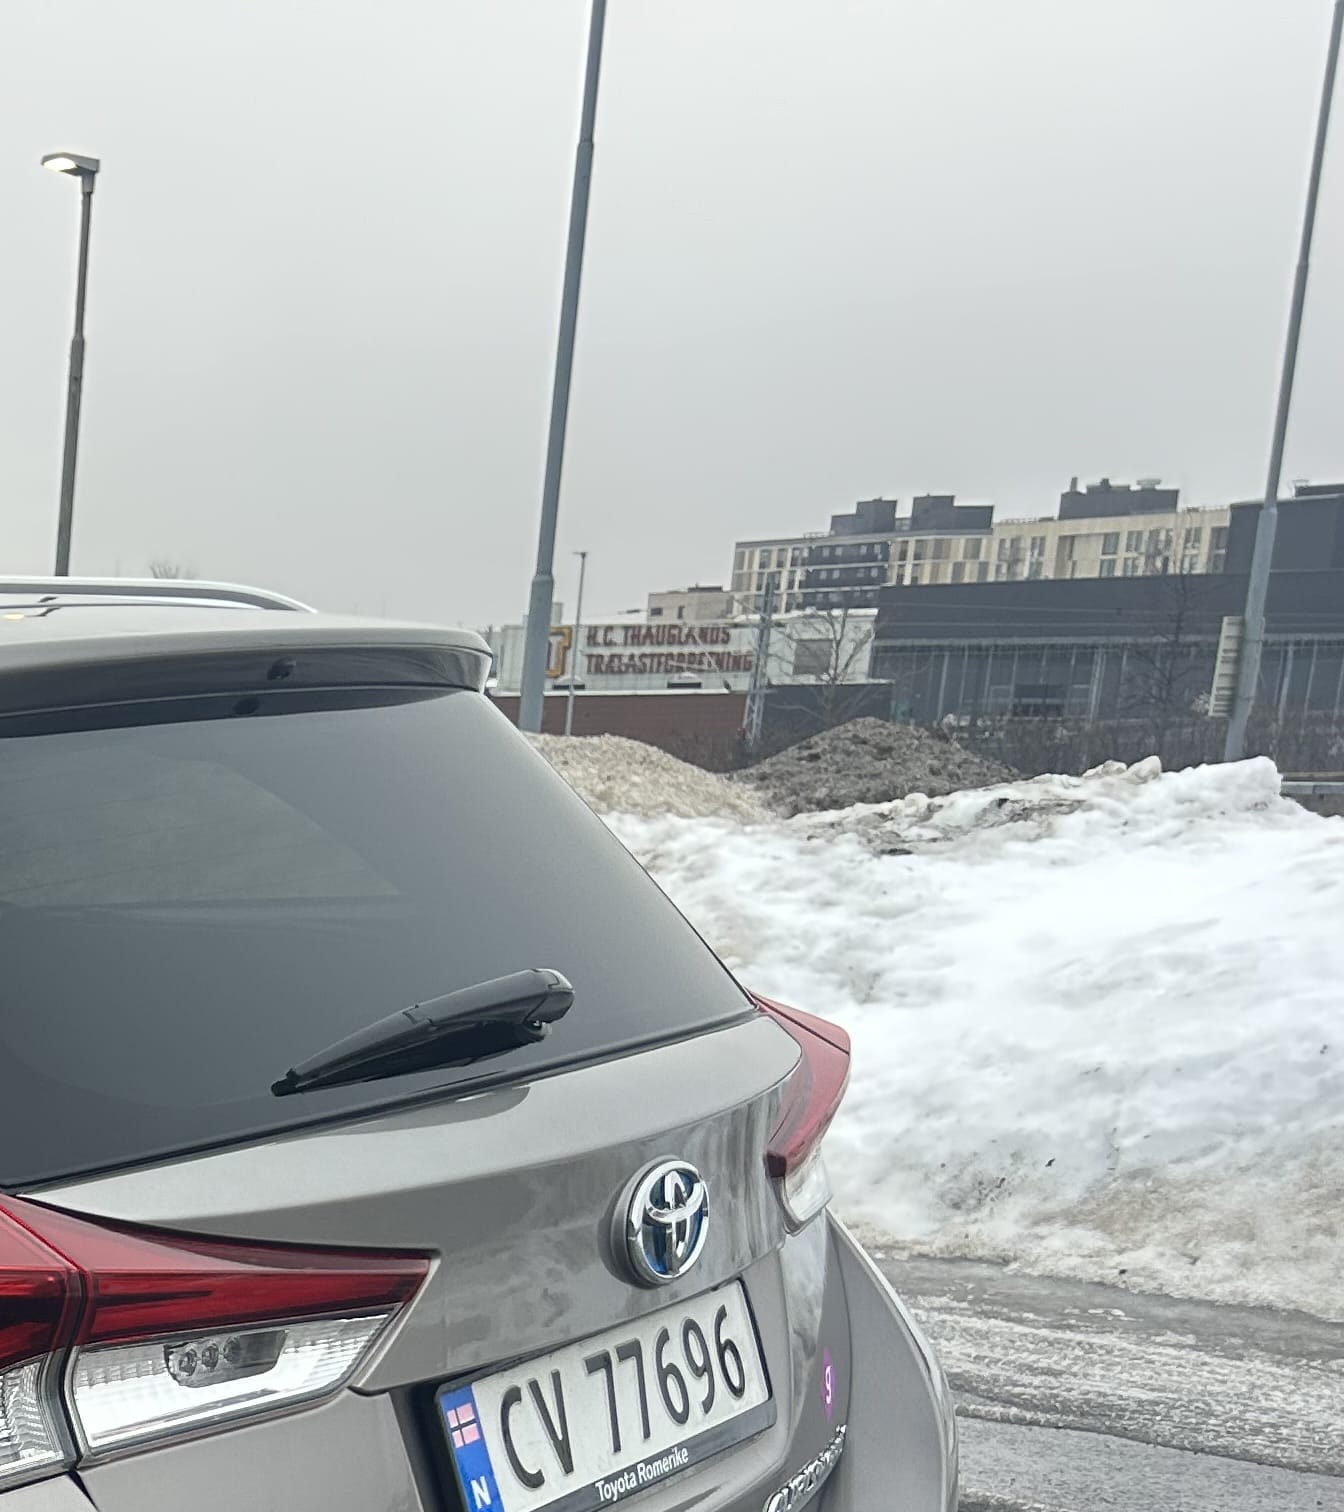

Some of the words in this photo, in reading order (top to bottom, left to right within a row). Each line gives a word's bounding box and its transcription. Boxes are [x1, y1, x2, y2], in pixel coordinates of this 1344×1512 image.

[500, 1369, 575, 1490] CV
[584, 1304, 746, 1454] 77696
[470, 1475, 492, 1509] N
[595, 1469, 637, 1502] Toyota
[637, 1446, 690, 1482] Romerike
